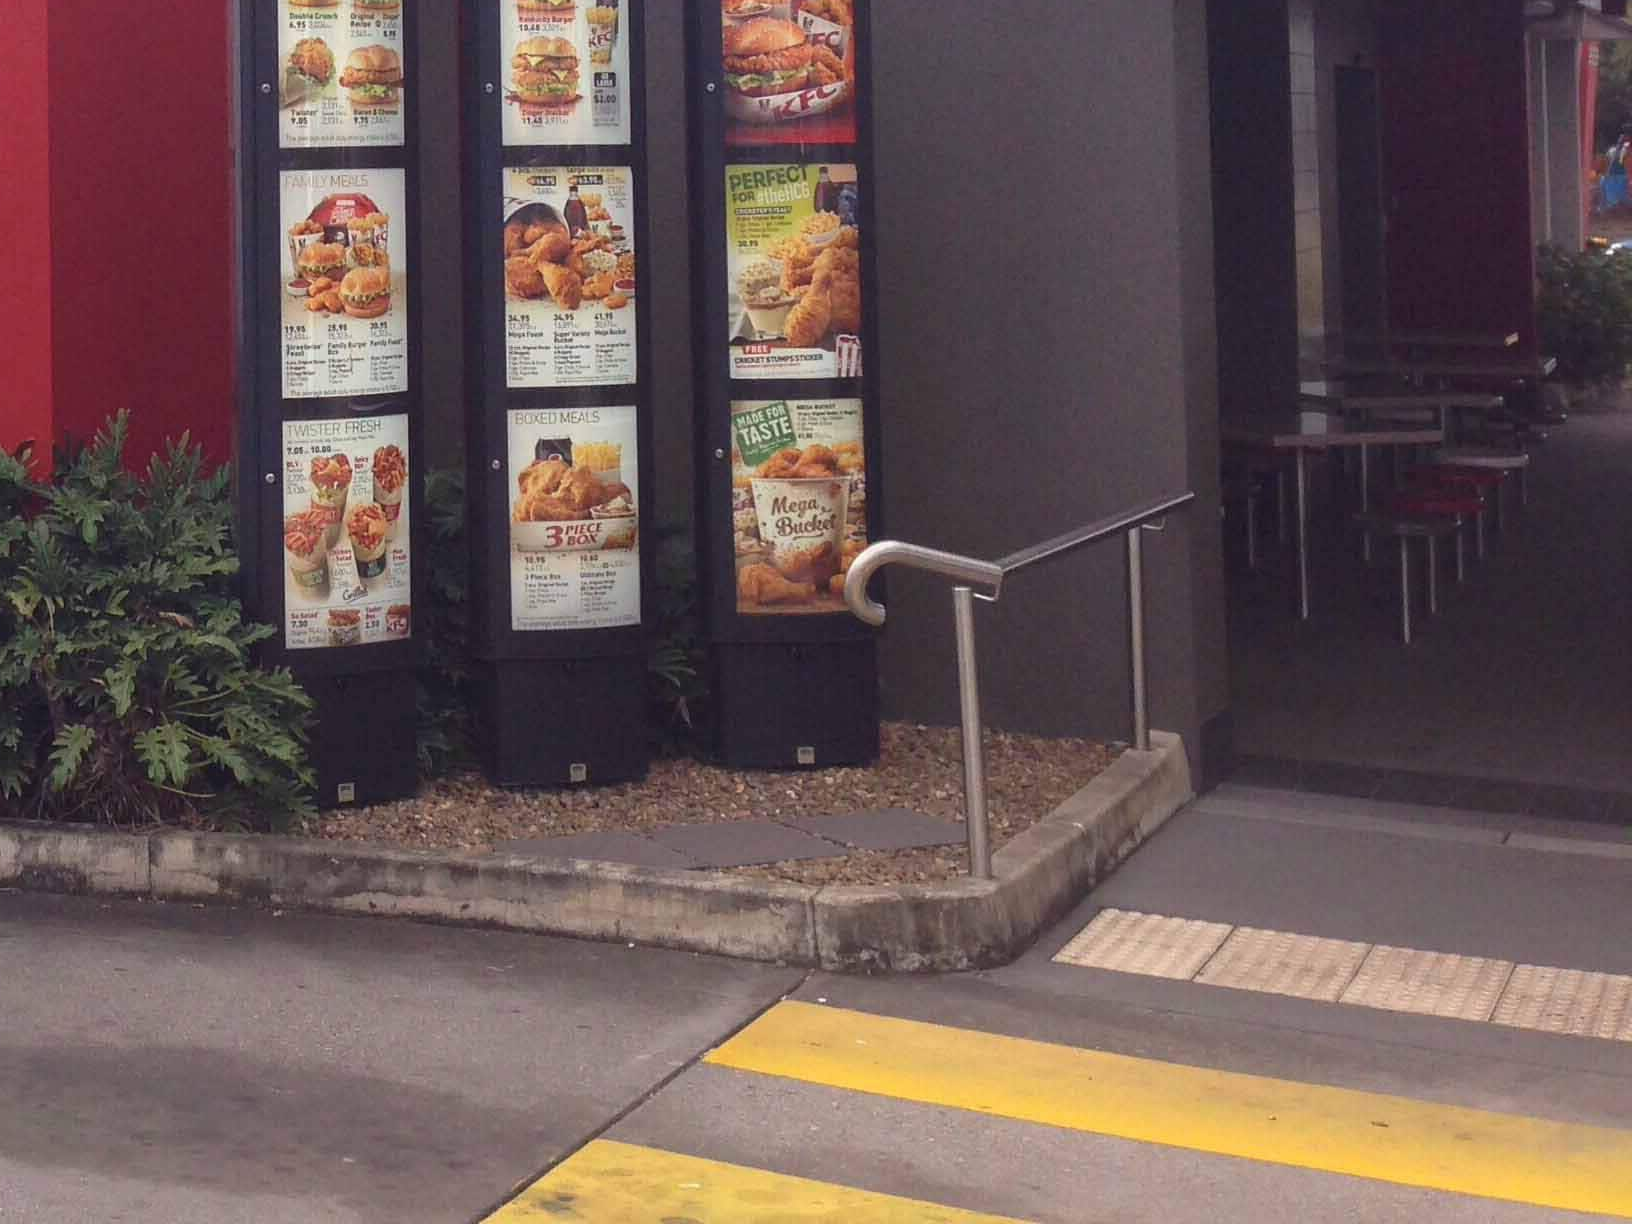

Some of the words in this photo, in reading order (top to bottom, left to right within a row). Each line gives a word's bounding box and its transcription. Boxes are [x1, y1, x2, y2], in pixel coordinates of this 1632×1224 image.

[552, 16, 574, 25] Burger
[588, 31, 614, 48] KFC
[774, 87, 838, 121] KFC
[285, 175, 329, 188] FAMILY
[331, 174, 369, 188] MEALS
[729, 166, 808, 192] PERFECT
[733, 190, 755, 203] FOR
[744, 345, 769, 354] FREE
[515, 412, 557, 425] BOXED
[560, 410, 601, 424] MEALS
[735, 410, 764, 428] MADE
[766, 404, 787, 419] FOR
[287, 424, 341, 438] TWISTER
[344, 420, 382, 434] FRESH
[738, 416, 792, 446] TASTE
[771, 495, 818, 519] Mega
[775, 513, 837, 537] Bucket
[544, 525, 564, 549] 3
[564, 521, 604, 535] PIECE
[566, 534, 598, 547] BOX
